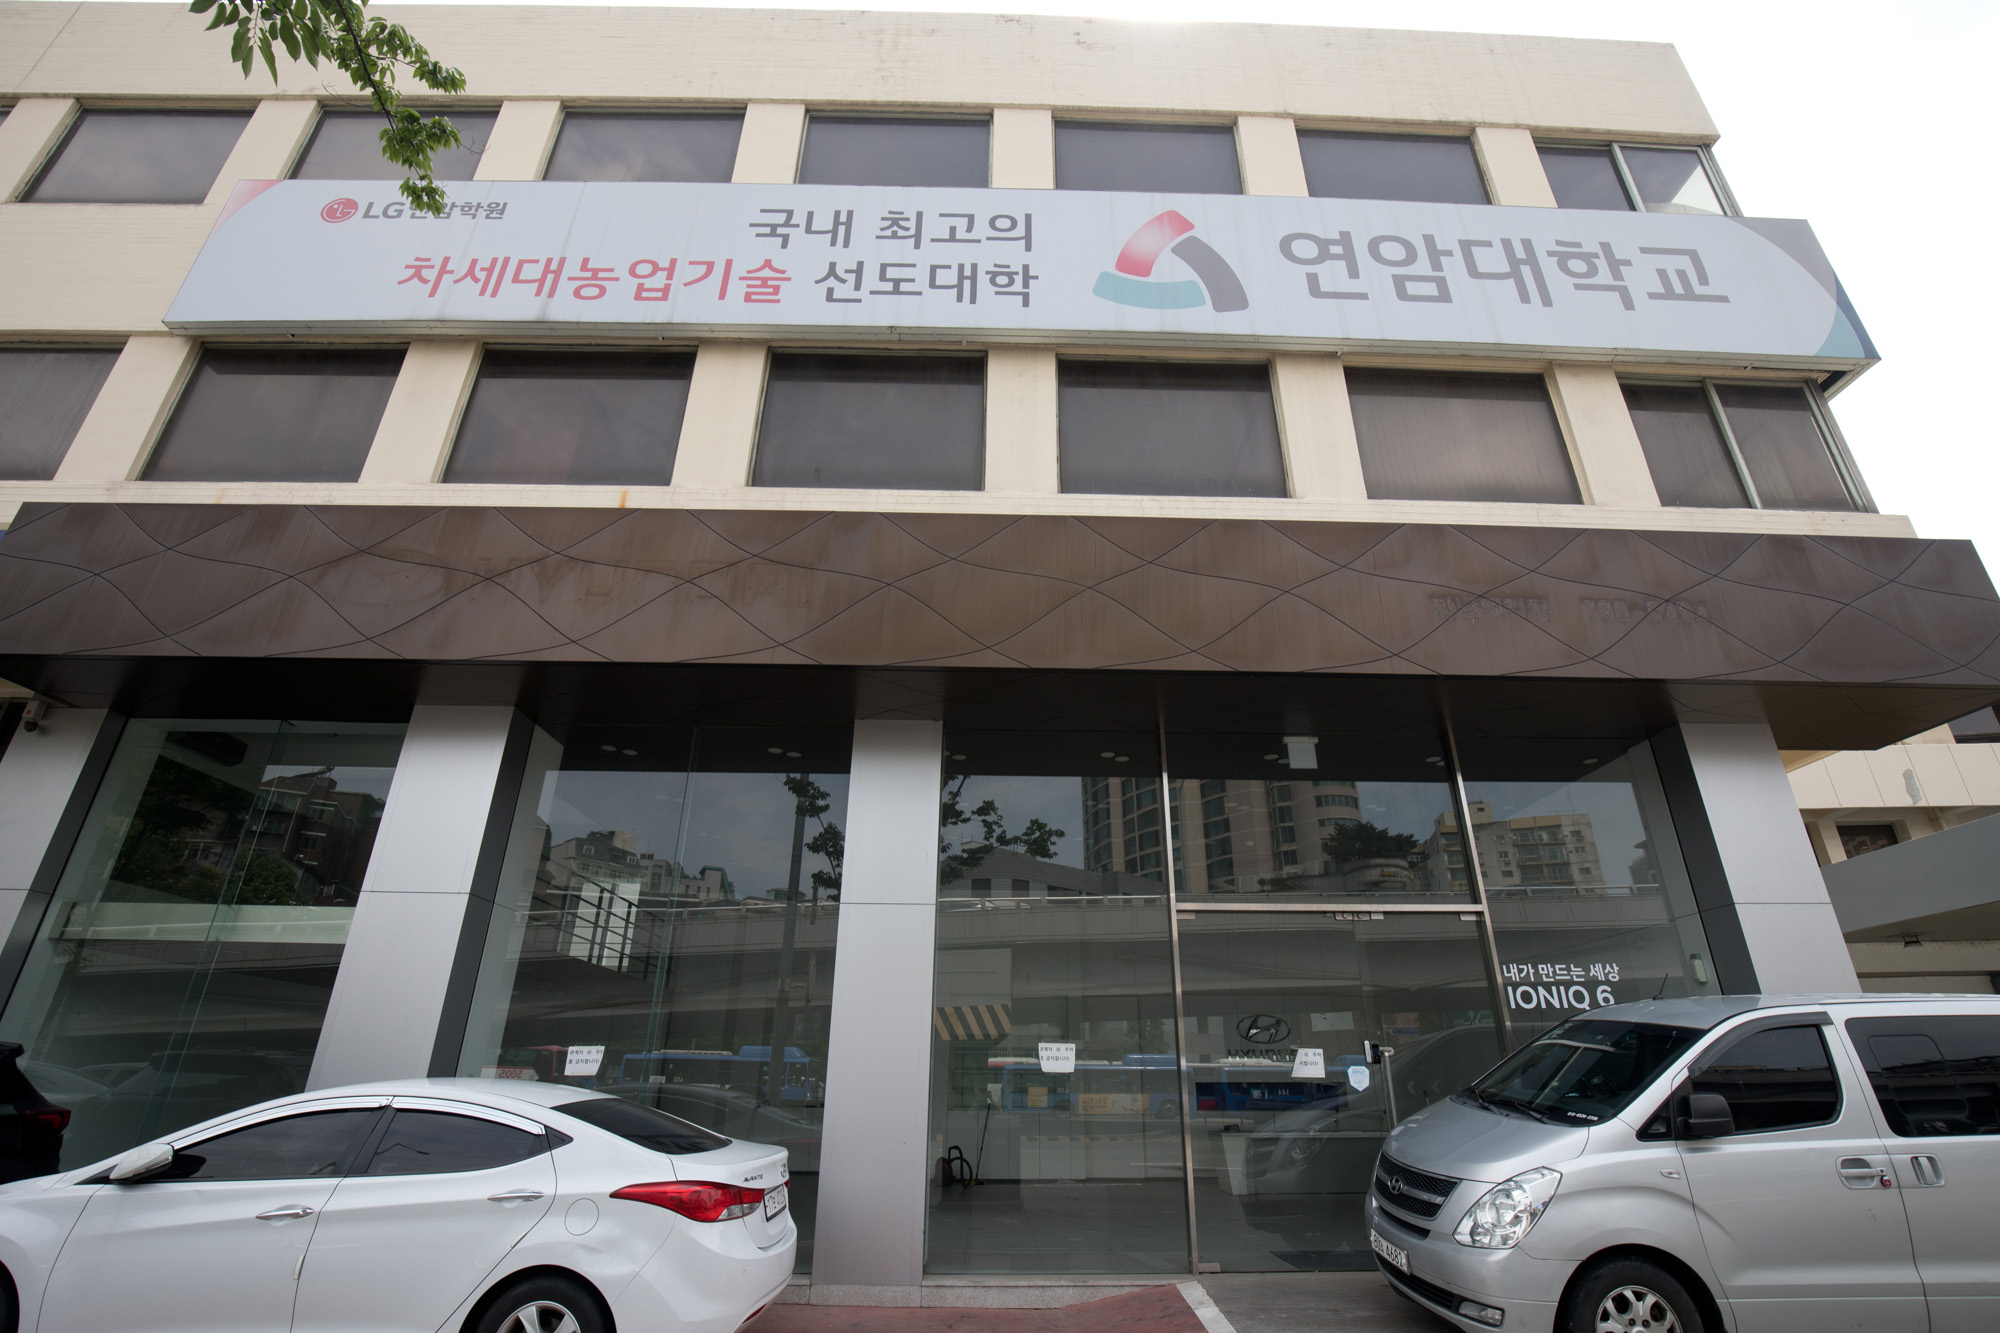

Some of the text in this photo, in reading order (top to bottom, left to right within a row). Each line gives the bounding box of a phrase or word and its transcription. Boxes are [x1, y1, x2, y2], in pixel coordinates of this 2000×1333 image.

[749, 209, 1034, 251] 국내 최고의
[397, 256, 1040, 308] 차세대농업기술 선도대학
[1278, 231, 1731, 312] 연암대학교
[1503, 963, 1620, 982] 내가 만드는 세상
[1507, 985, 1615, 1010] IONIQ 6
